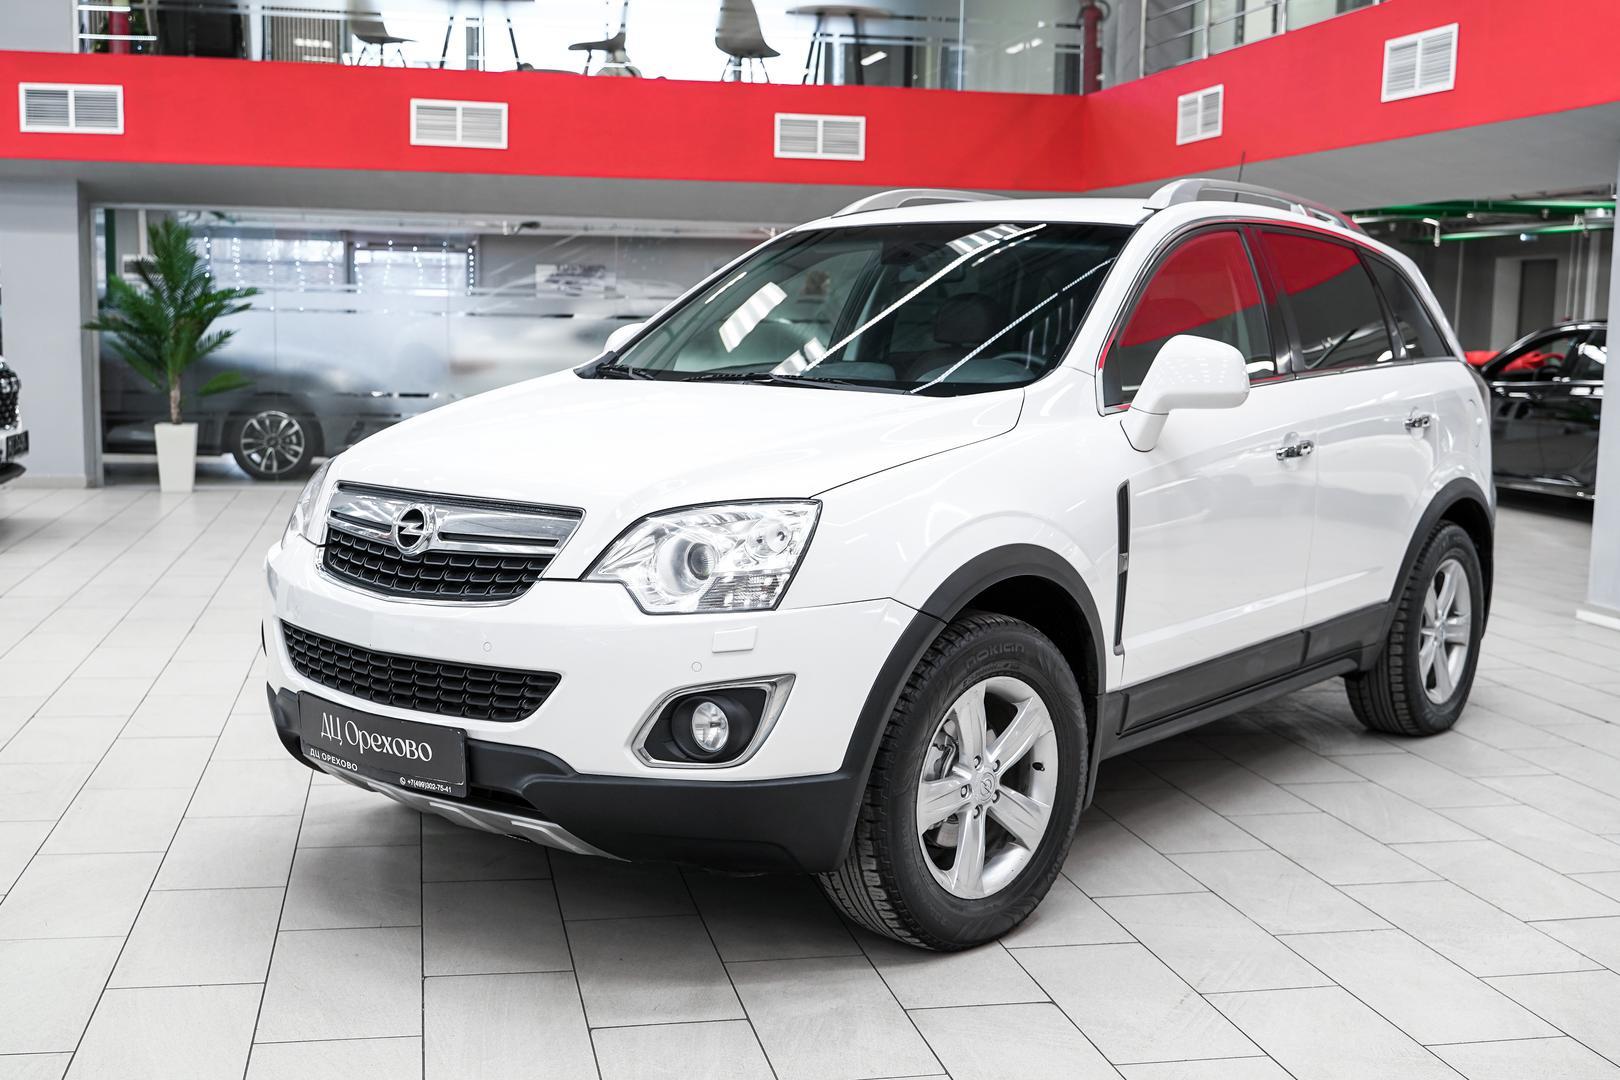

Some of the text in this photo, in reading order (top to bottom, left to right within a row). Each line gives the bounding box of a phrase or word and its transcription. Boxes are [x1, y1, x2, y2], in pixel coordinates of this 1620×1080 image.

[321, 712, 433, 762] ДЦ Орехово
[310, 748, 358, 772] ДЦ ОРЕХОВО
